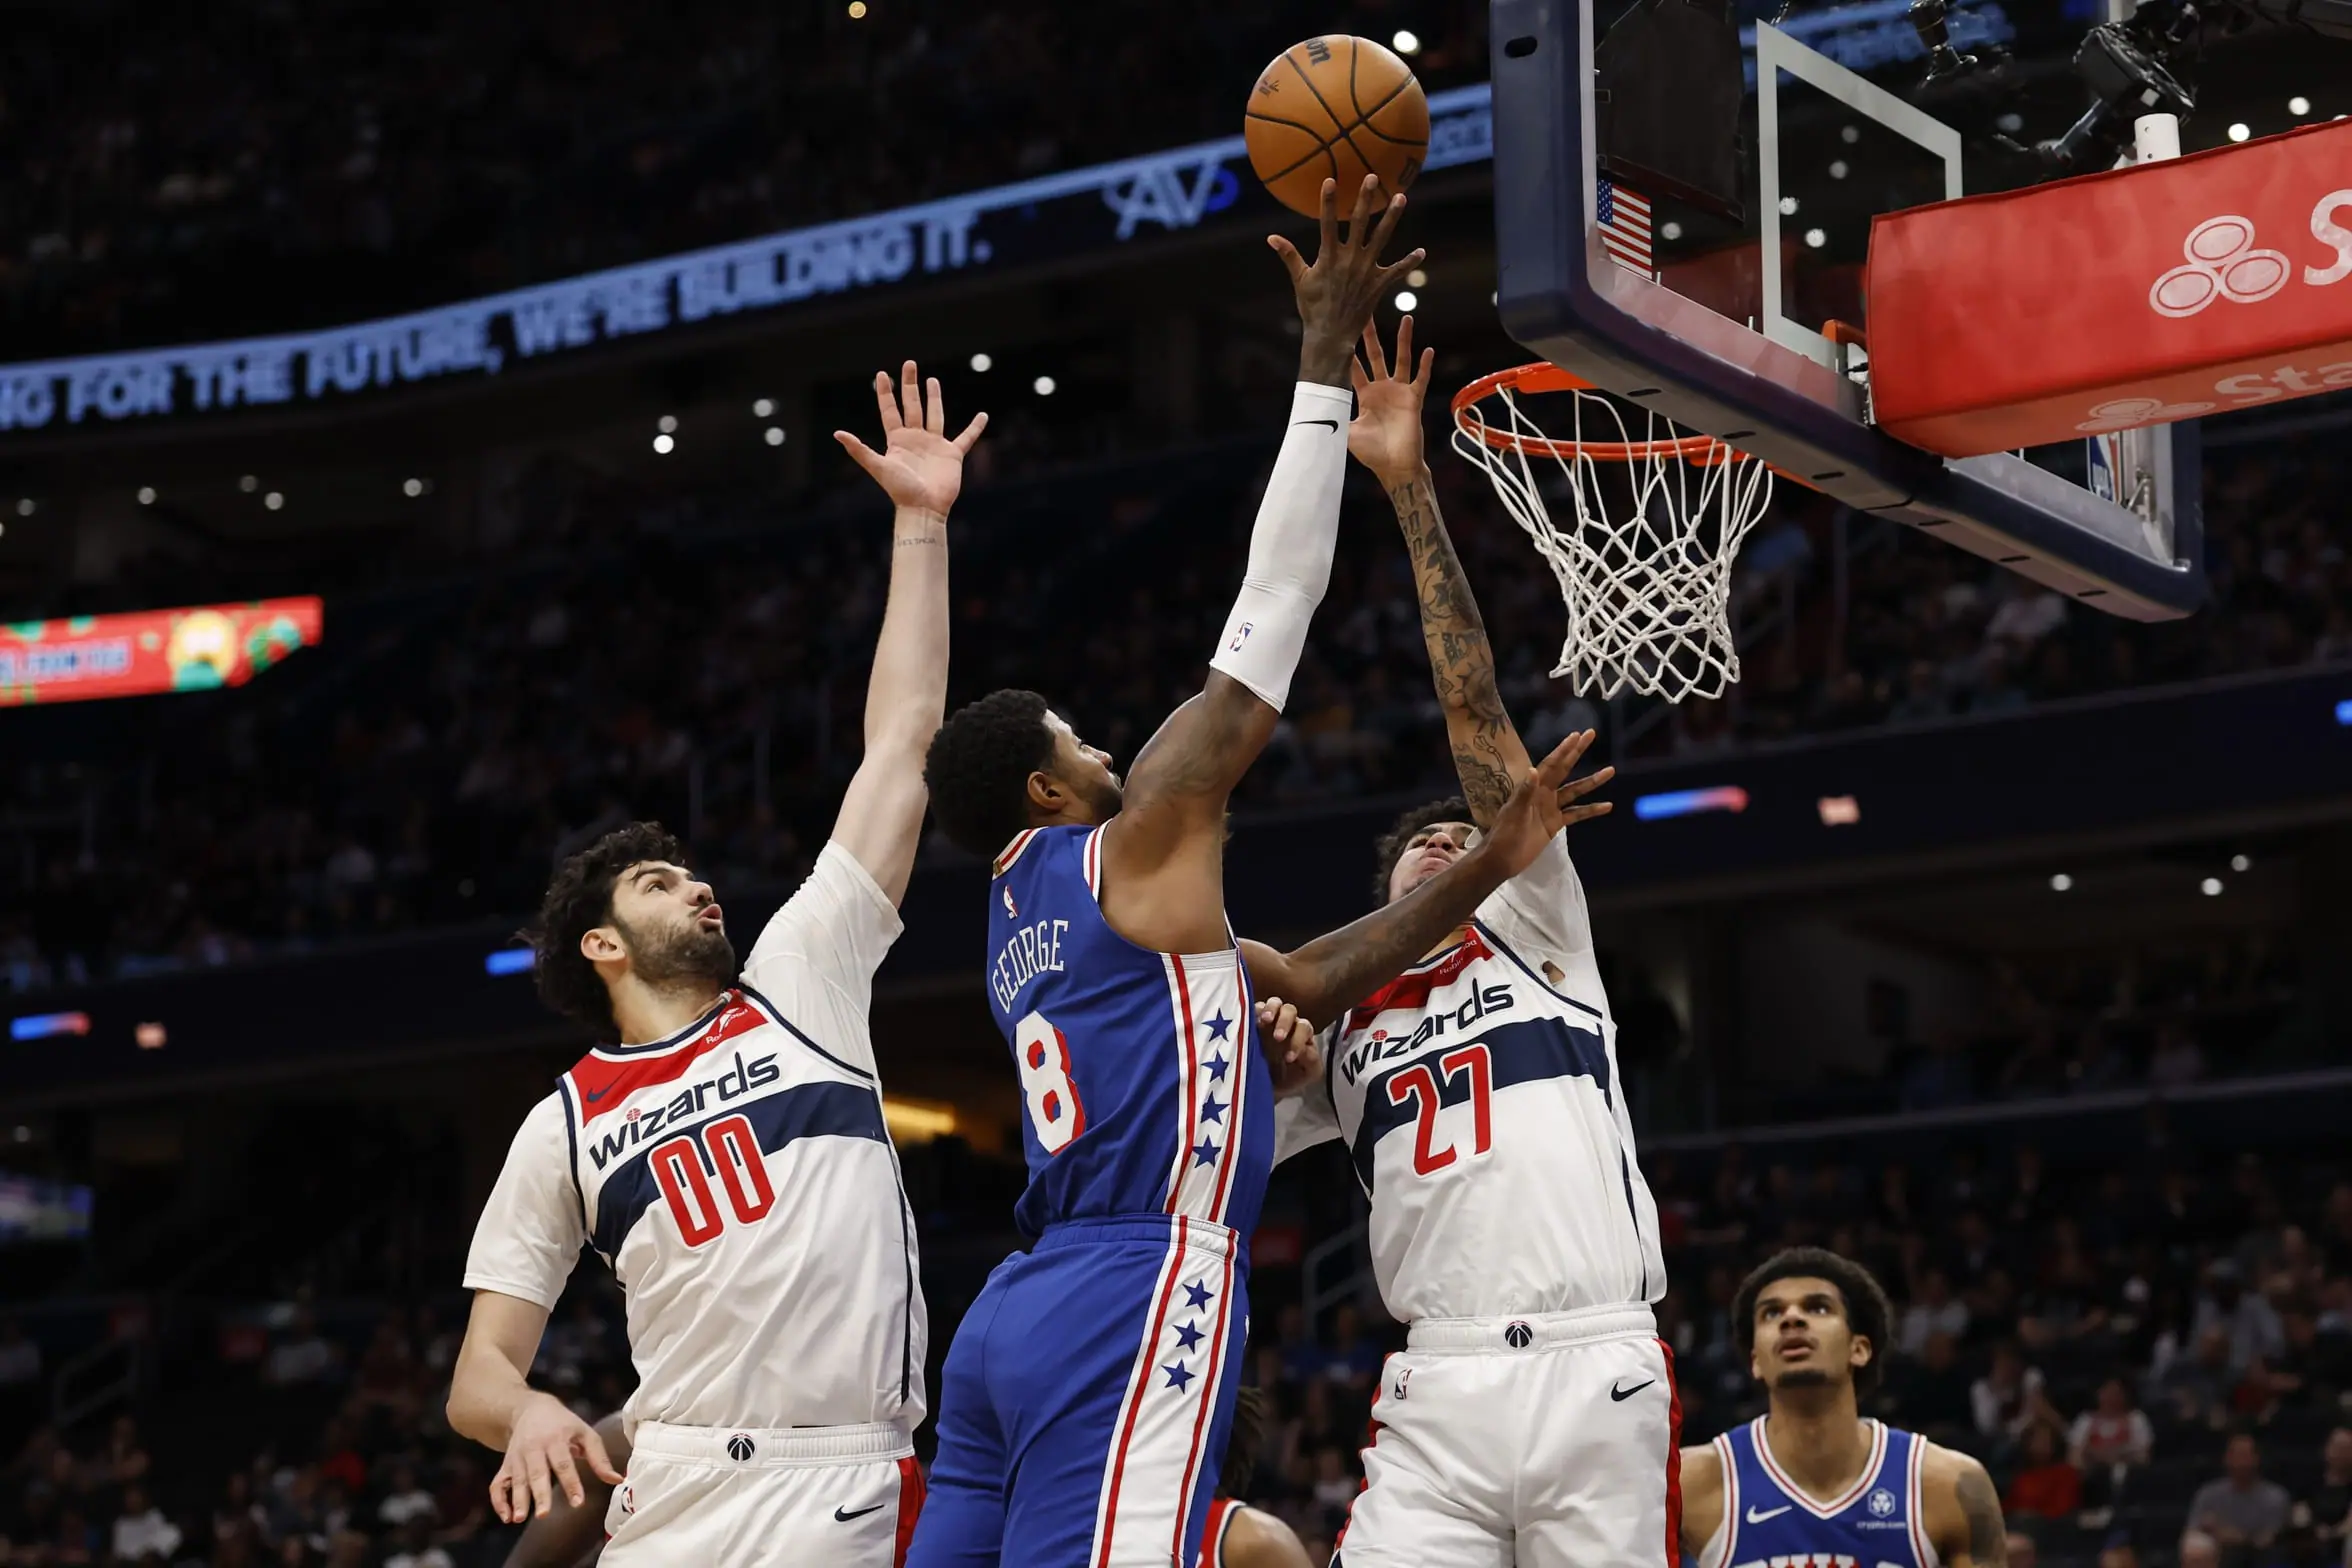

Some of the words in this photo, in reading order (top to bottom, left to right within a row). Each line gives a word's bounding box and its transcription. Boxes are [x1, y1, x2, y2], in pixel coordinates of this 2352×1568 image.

[69, 364, 174, 424] FOR
[192, 354, 292, 408] THE
[308, 321, 503, 397] FUTURE,
[677, 222, 916, 320] BUILDING
[992, 919, 1069, 1014] GEORGE
[1341, 977, 1514, 1087] wizards
[589, 1051, 780, 1171] wizards
[1016, 1010, 1087, 1157] 8
[1386, 1043, 1494, 1178] 27
[649, 1115, 777, 1249] 00
